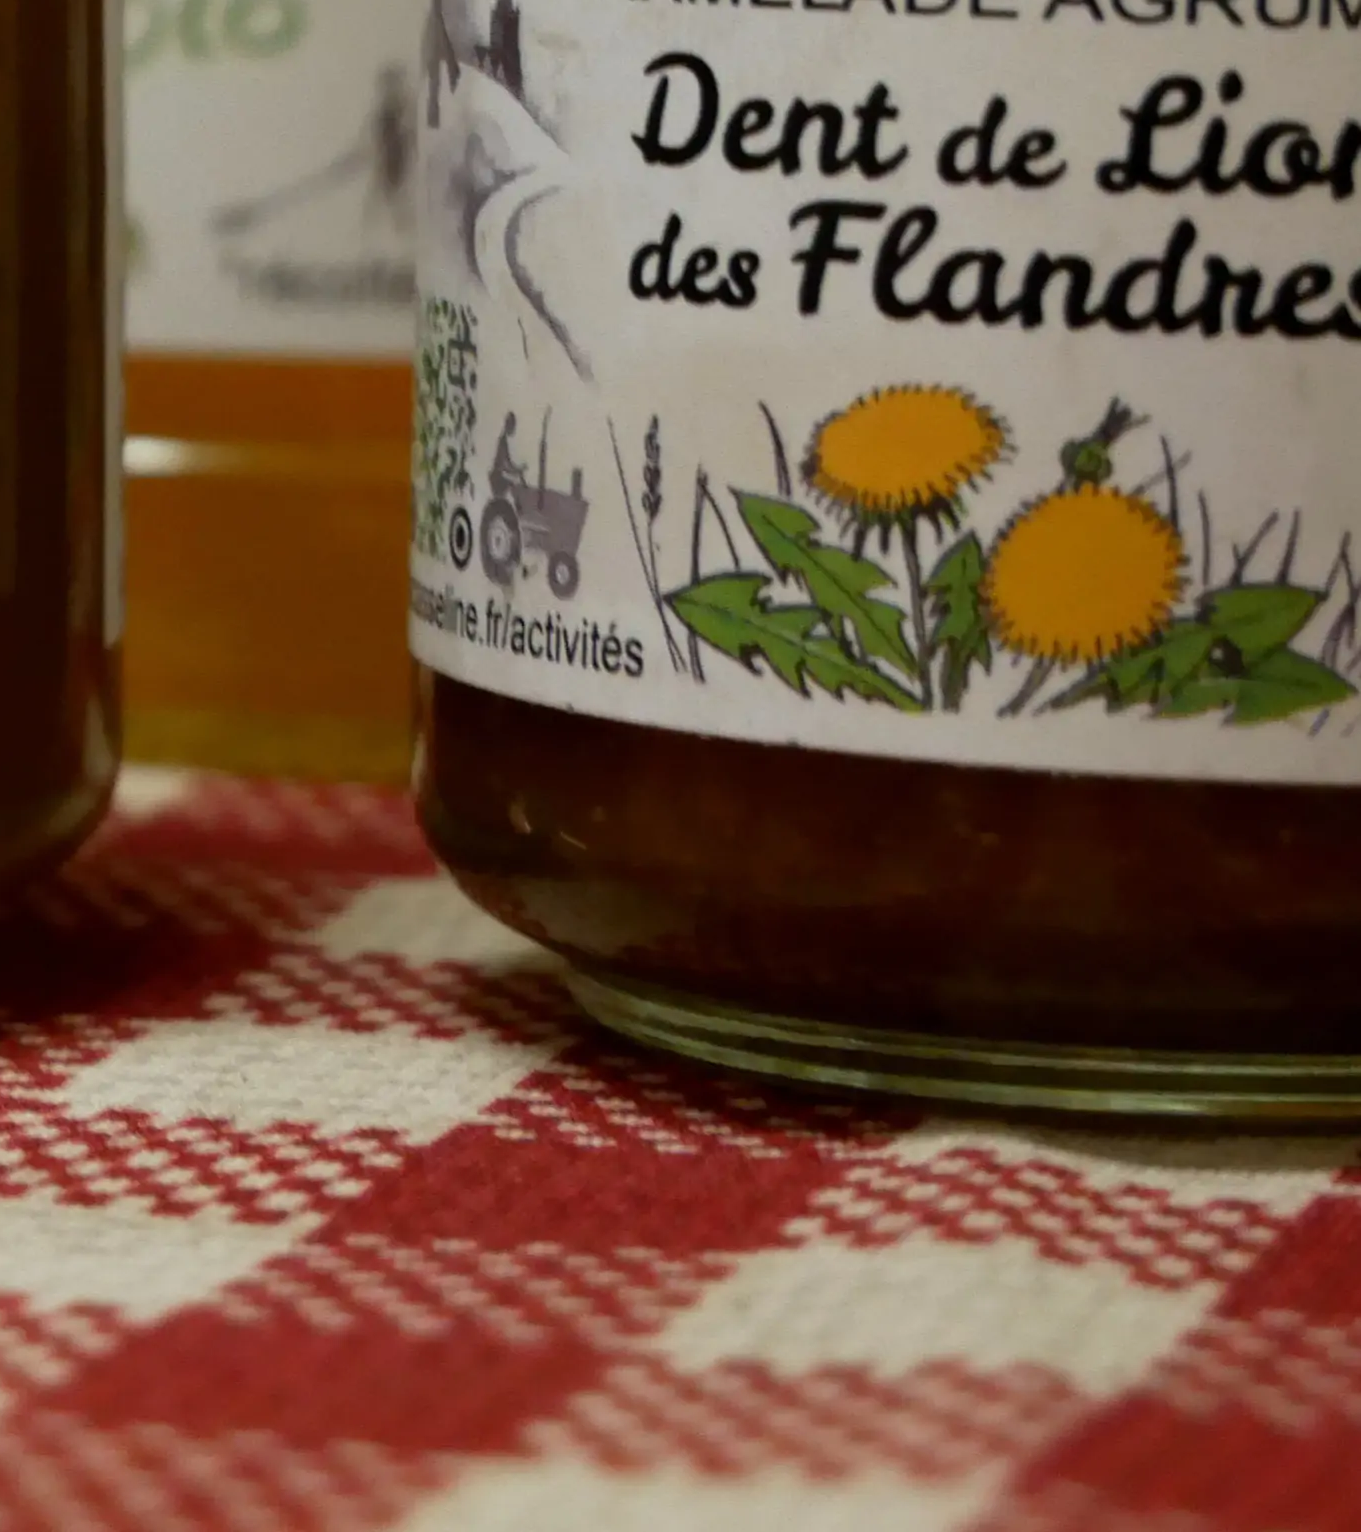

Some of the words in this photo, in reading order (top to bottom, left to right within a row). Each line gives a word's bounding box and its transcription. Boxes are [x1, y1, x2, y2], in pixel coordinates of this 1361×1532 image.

[630, 51, 909, 180] Dent
[936, 96, 1068, 189] de
[628, 212, 761, 310] des
